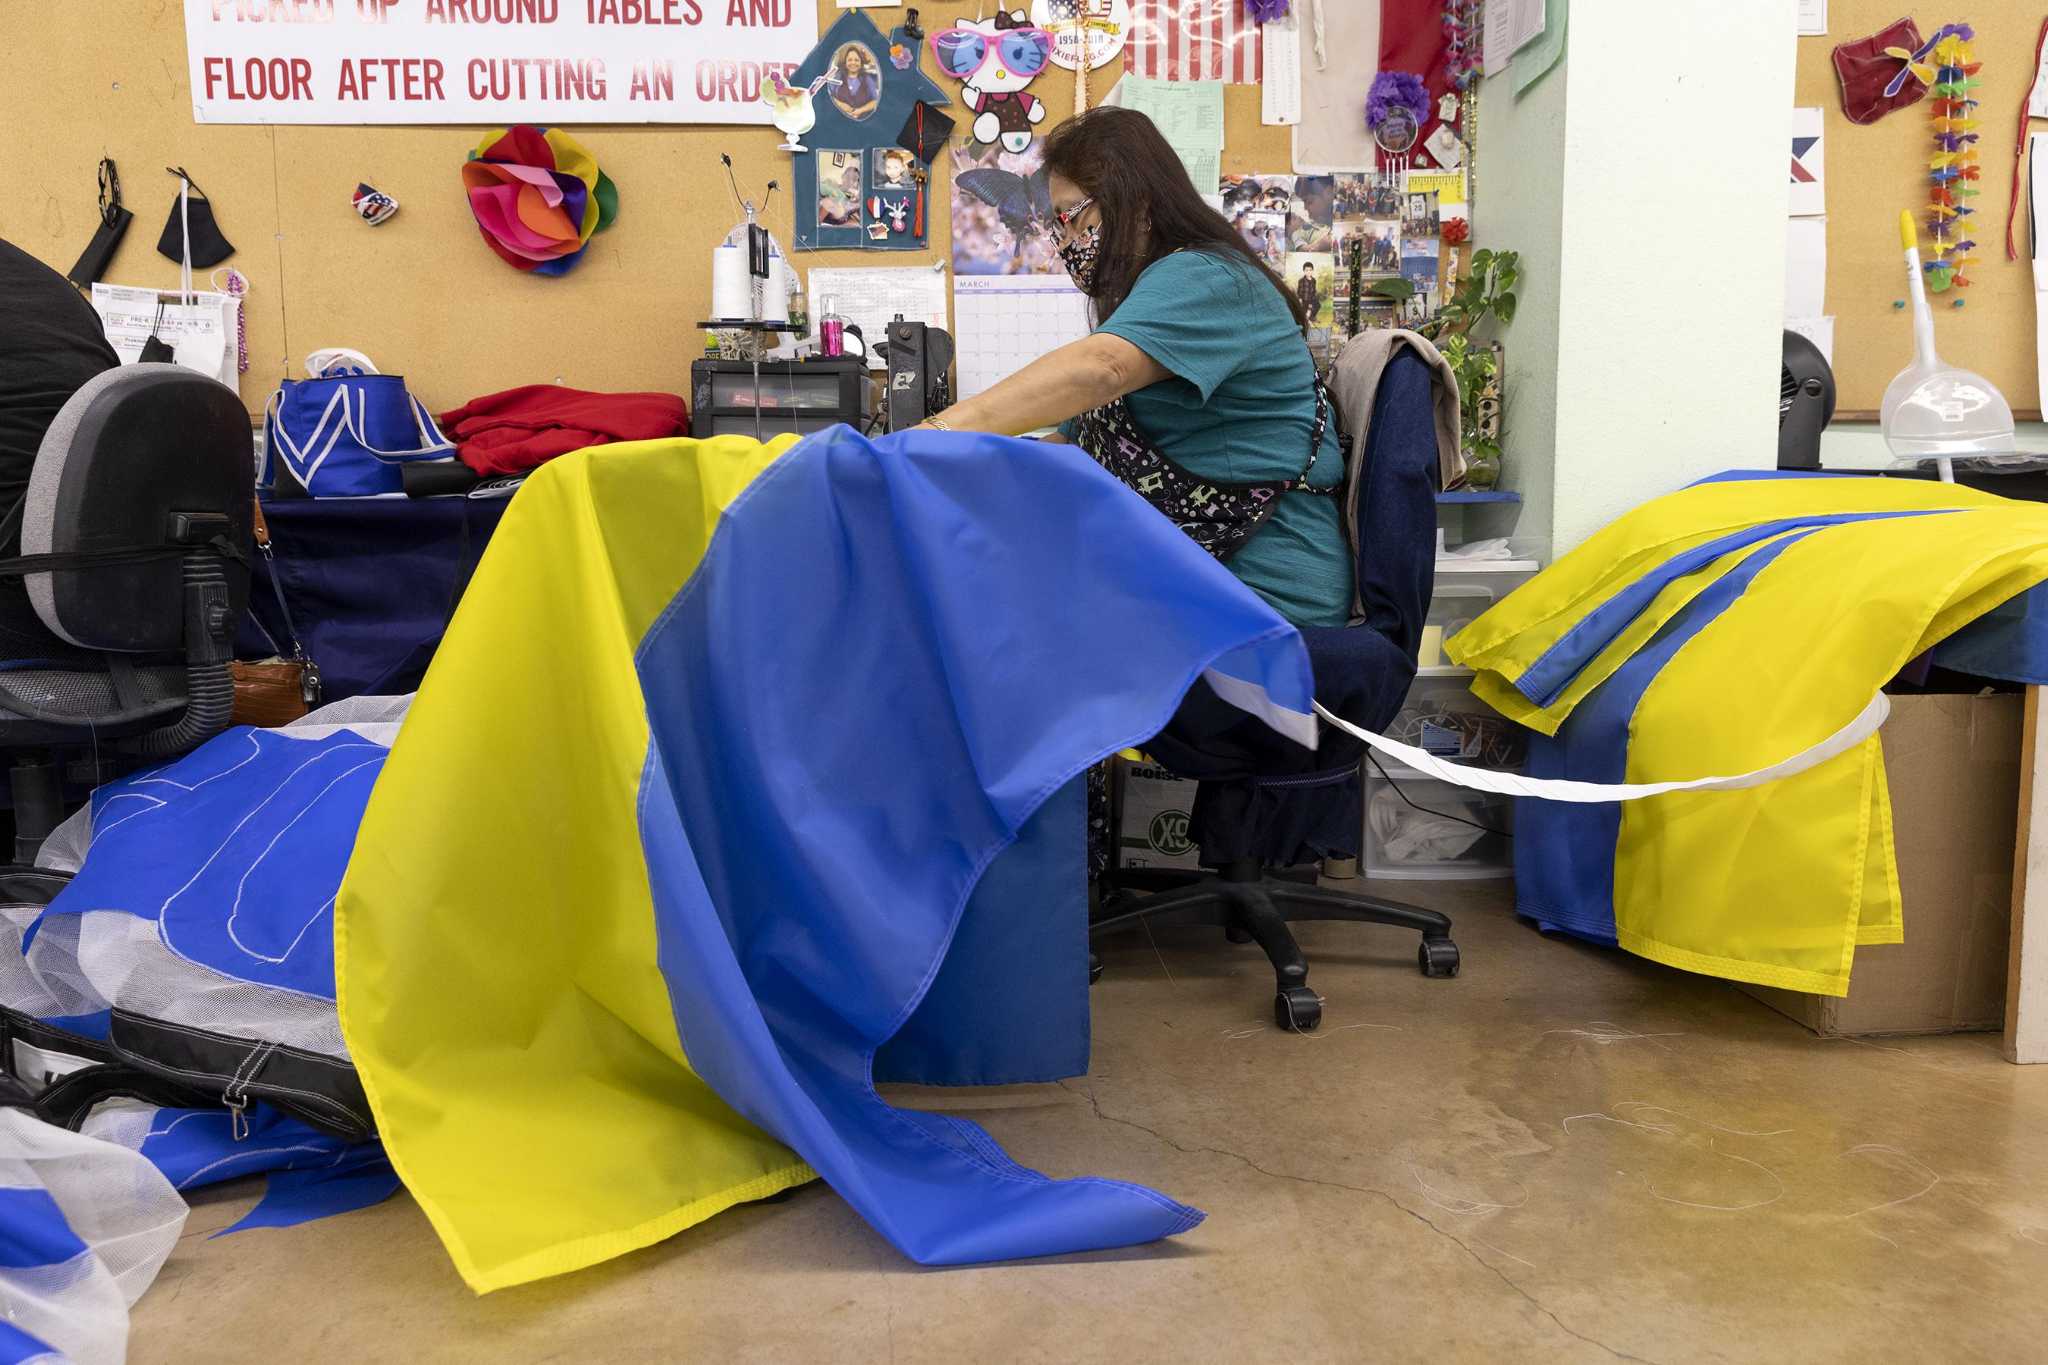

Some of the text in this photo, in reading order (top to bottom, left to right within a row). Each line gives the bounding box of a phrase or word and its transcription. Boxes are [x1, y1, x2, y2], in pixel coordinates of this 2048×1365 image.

[424, 0, 559, 24] AROUND
[726, 0, 792, 27] AND
[203, 56, 314, 101] FLOOR
[337, 58, 446, 101] AFTER
[467, 57, 608, 101] CUTTING
[629, 58, 675, 101] AN
[959, 280, 991, 289] MARCH
